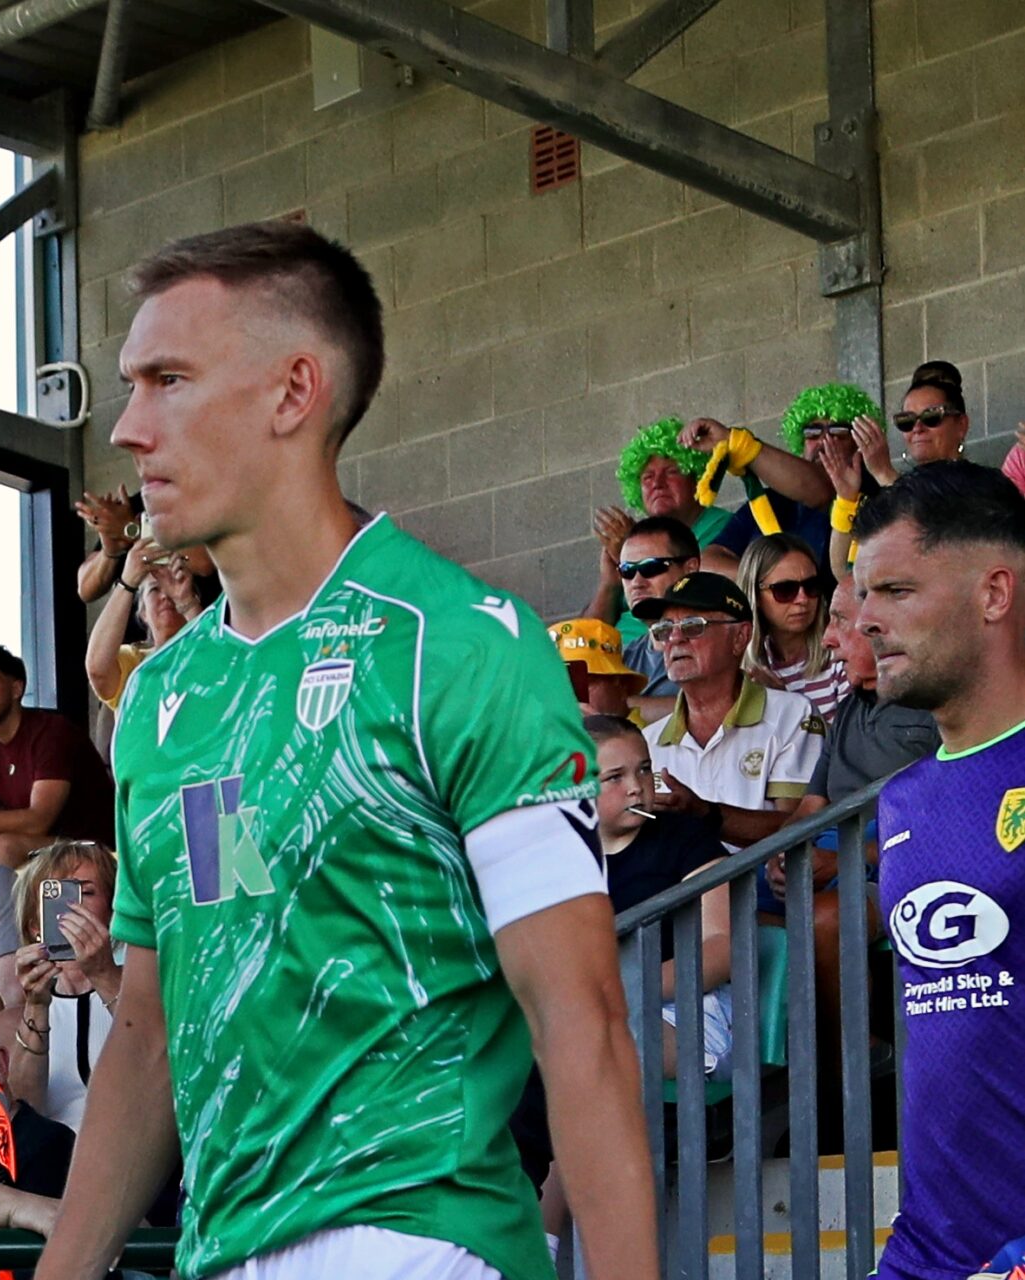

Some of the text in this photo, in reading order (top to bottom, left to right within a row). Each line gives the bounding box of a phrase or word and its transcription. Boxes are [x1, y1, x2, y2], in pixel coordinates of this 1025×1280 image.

[916, 892, 977, 951] G
[957, 973, 992, 991] Skip
[998, 971, 1014, 986] &
[935, 996, 967, 1012] Hire
[971, 991, 1009, 1008] Ltd.
